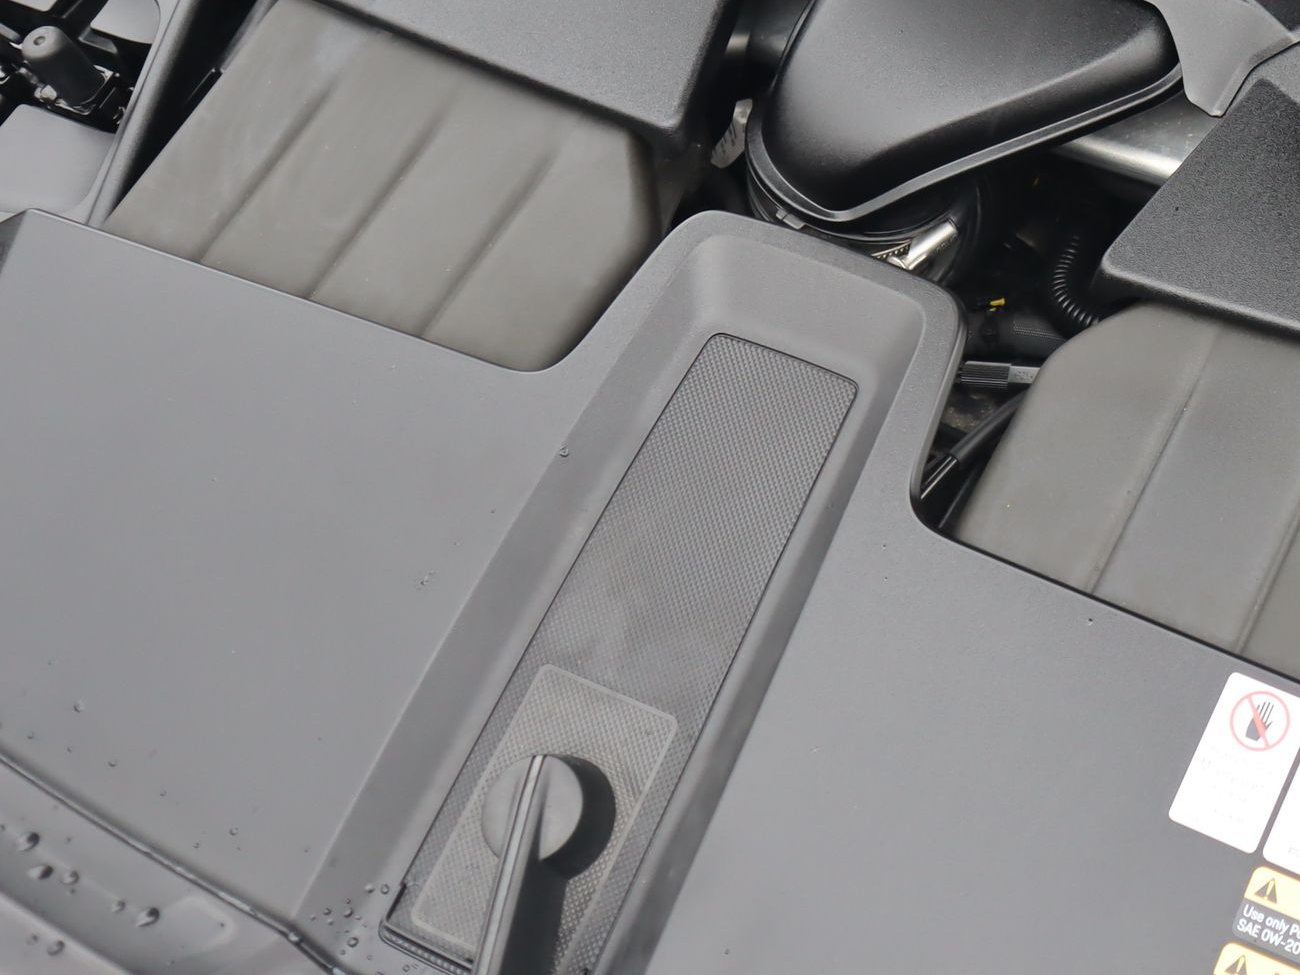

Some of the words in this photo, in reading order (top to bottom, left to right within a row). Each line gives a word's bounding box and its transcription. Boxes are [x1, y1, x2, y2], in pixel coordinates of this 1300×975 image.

[1237, 918, 1261, 938] SAE
[1243, 904, 1264, 923] Use
[1265, 917, 1289, 935] only
